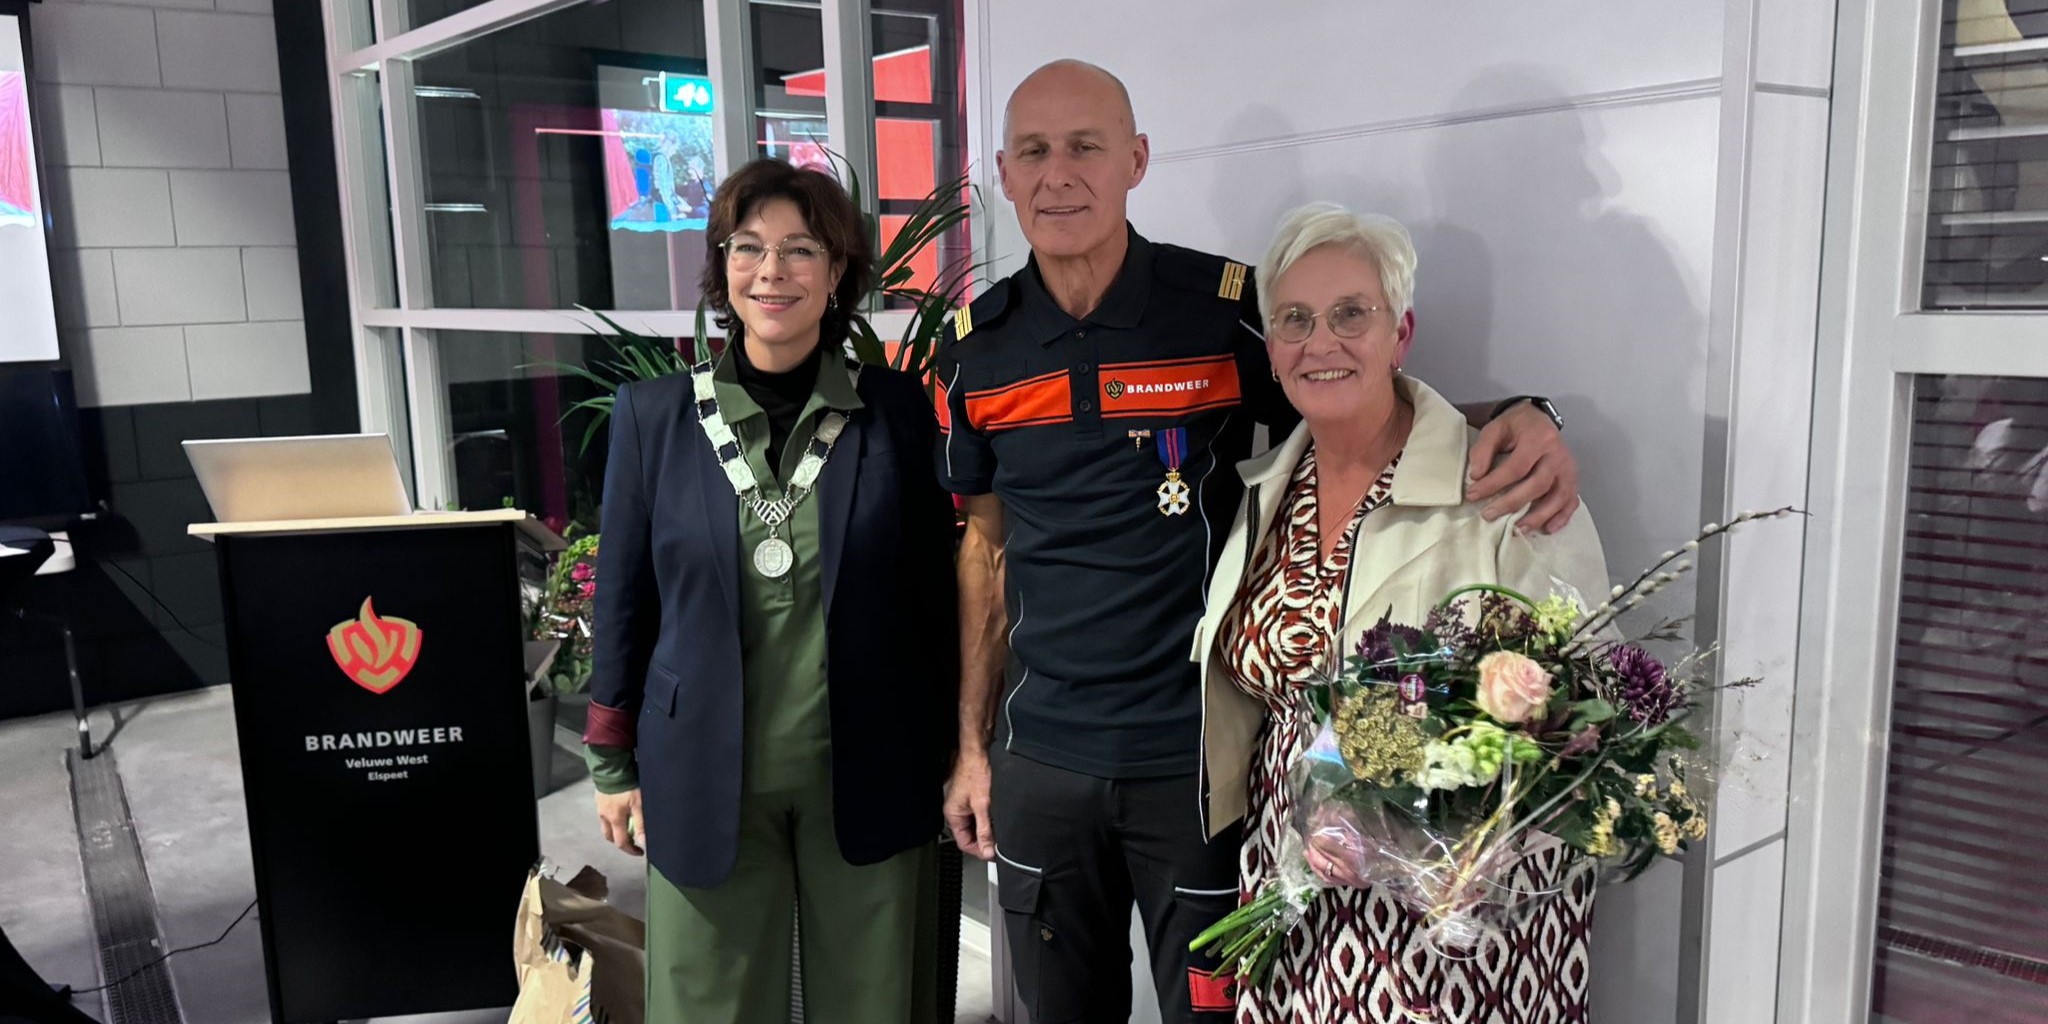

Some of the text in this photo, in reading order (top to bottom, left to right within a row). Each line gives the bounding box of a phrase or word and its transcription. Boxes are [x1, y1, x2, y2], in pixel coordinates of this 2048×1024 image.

[1127, 379, 1209, 394] BRANDWEER
[305, 726, 463, 751] BRANDWEER
[345, 754, 429, 769] Veluwe West
[367, 770, 409, 782] Elspeet
